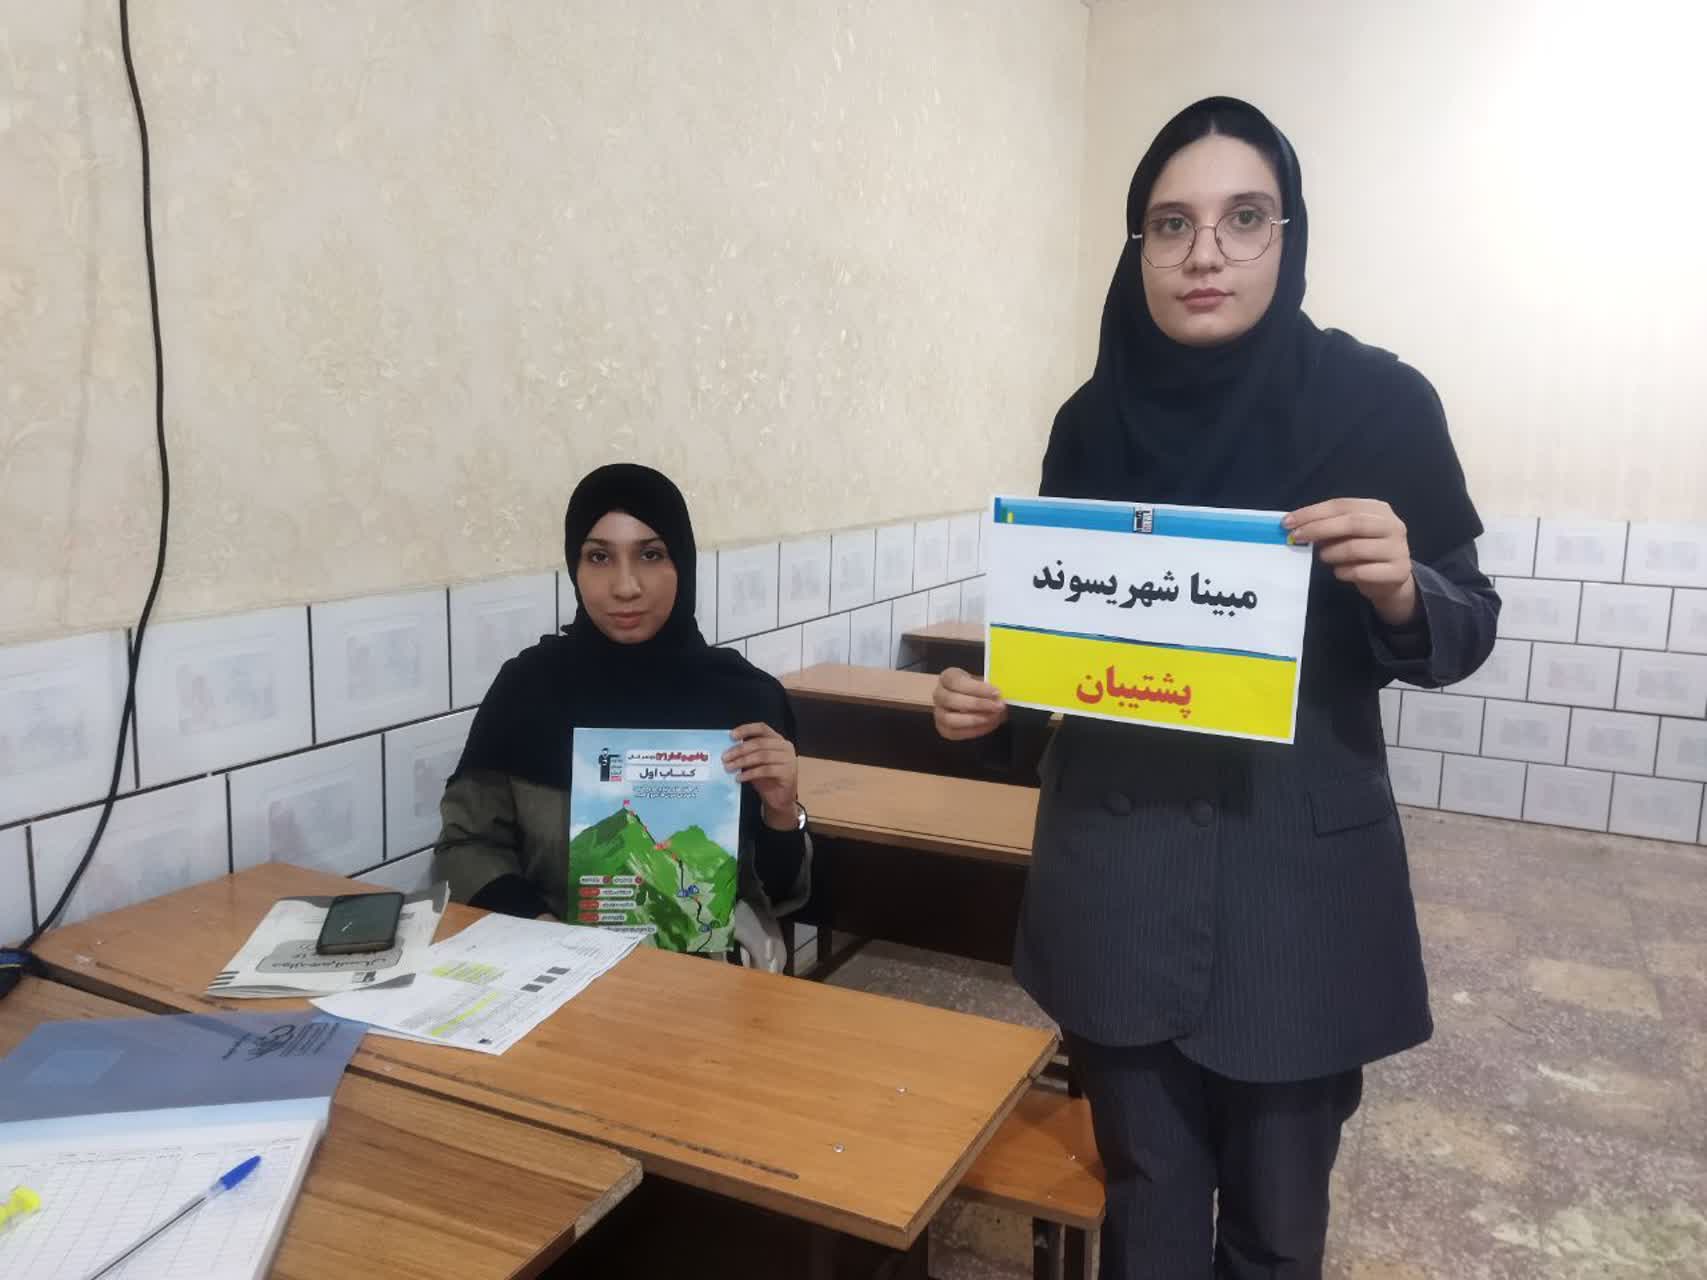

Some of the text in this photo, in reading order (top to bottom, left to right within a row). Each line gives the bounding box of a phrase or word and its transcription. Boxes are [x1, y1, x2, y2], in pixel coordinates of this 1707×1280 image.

[1190, 572, 1259, 617] مبینا
[1076, 665, 1192, 718] پشتیبان
[640, 767, 696, 779] کتاب اول
